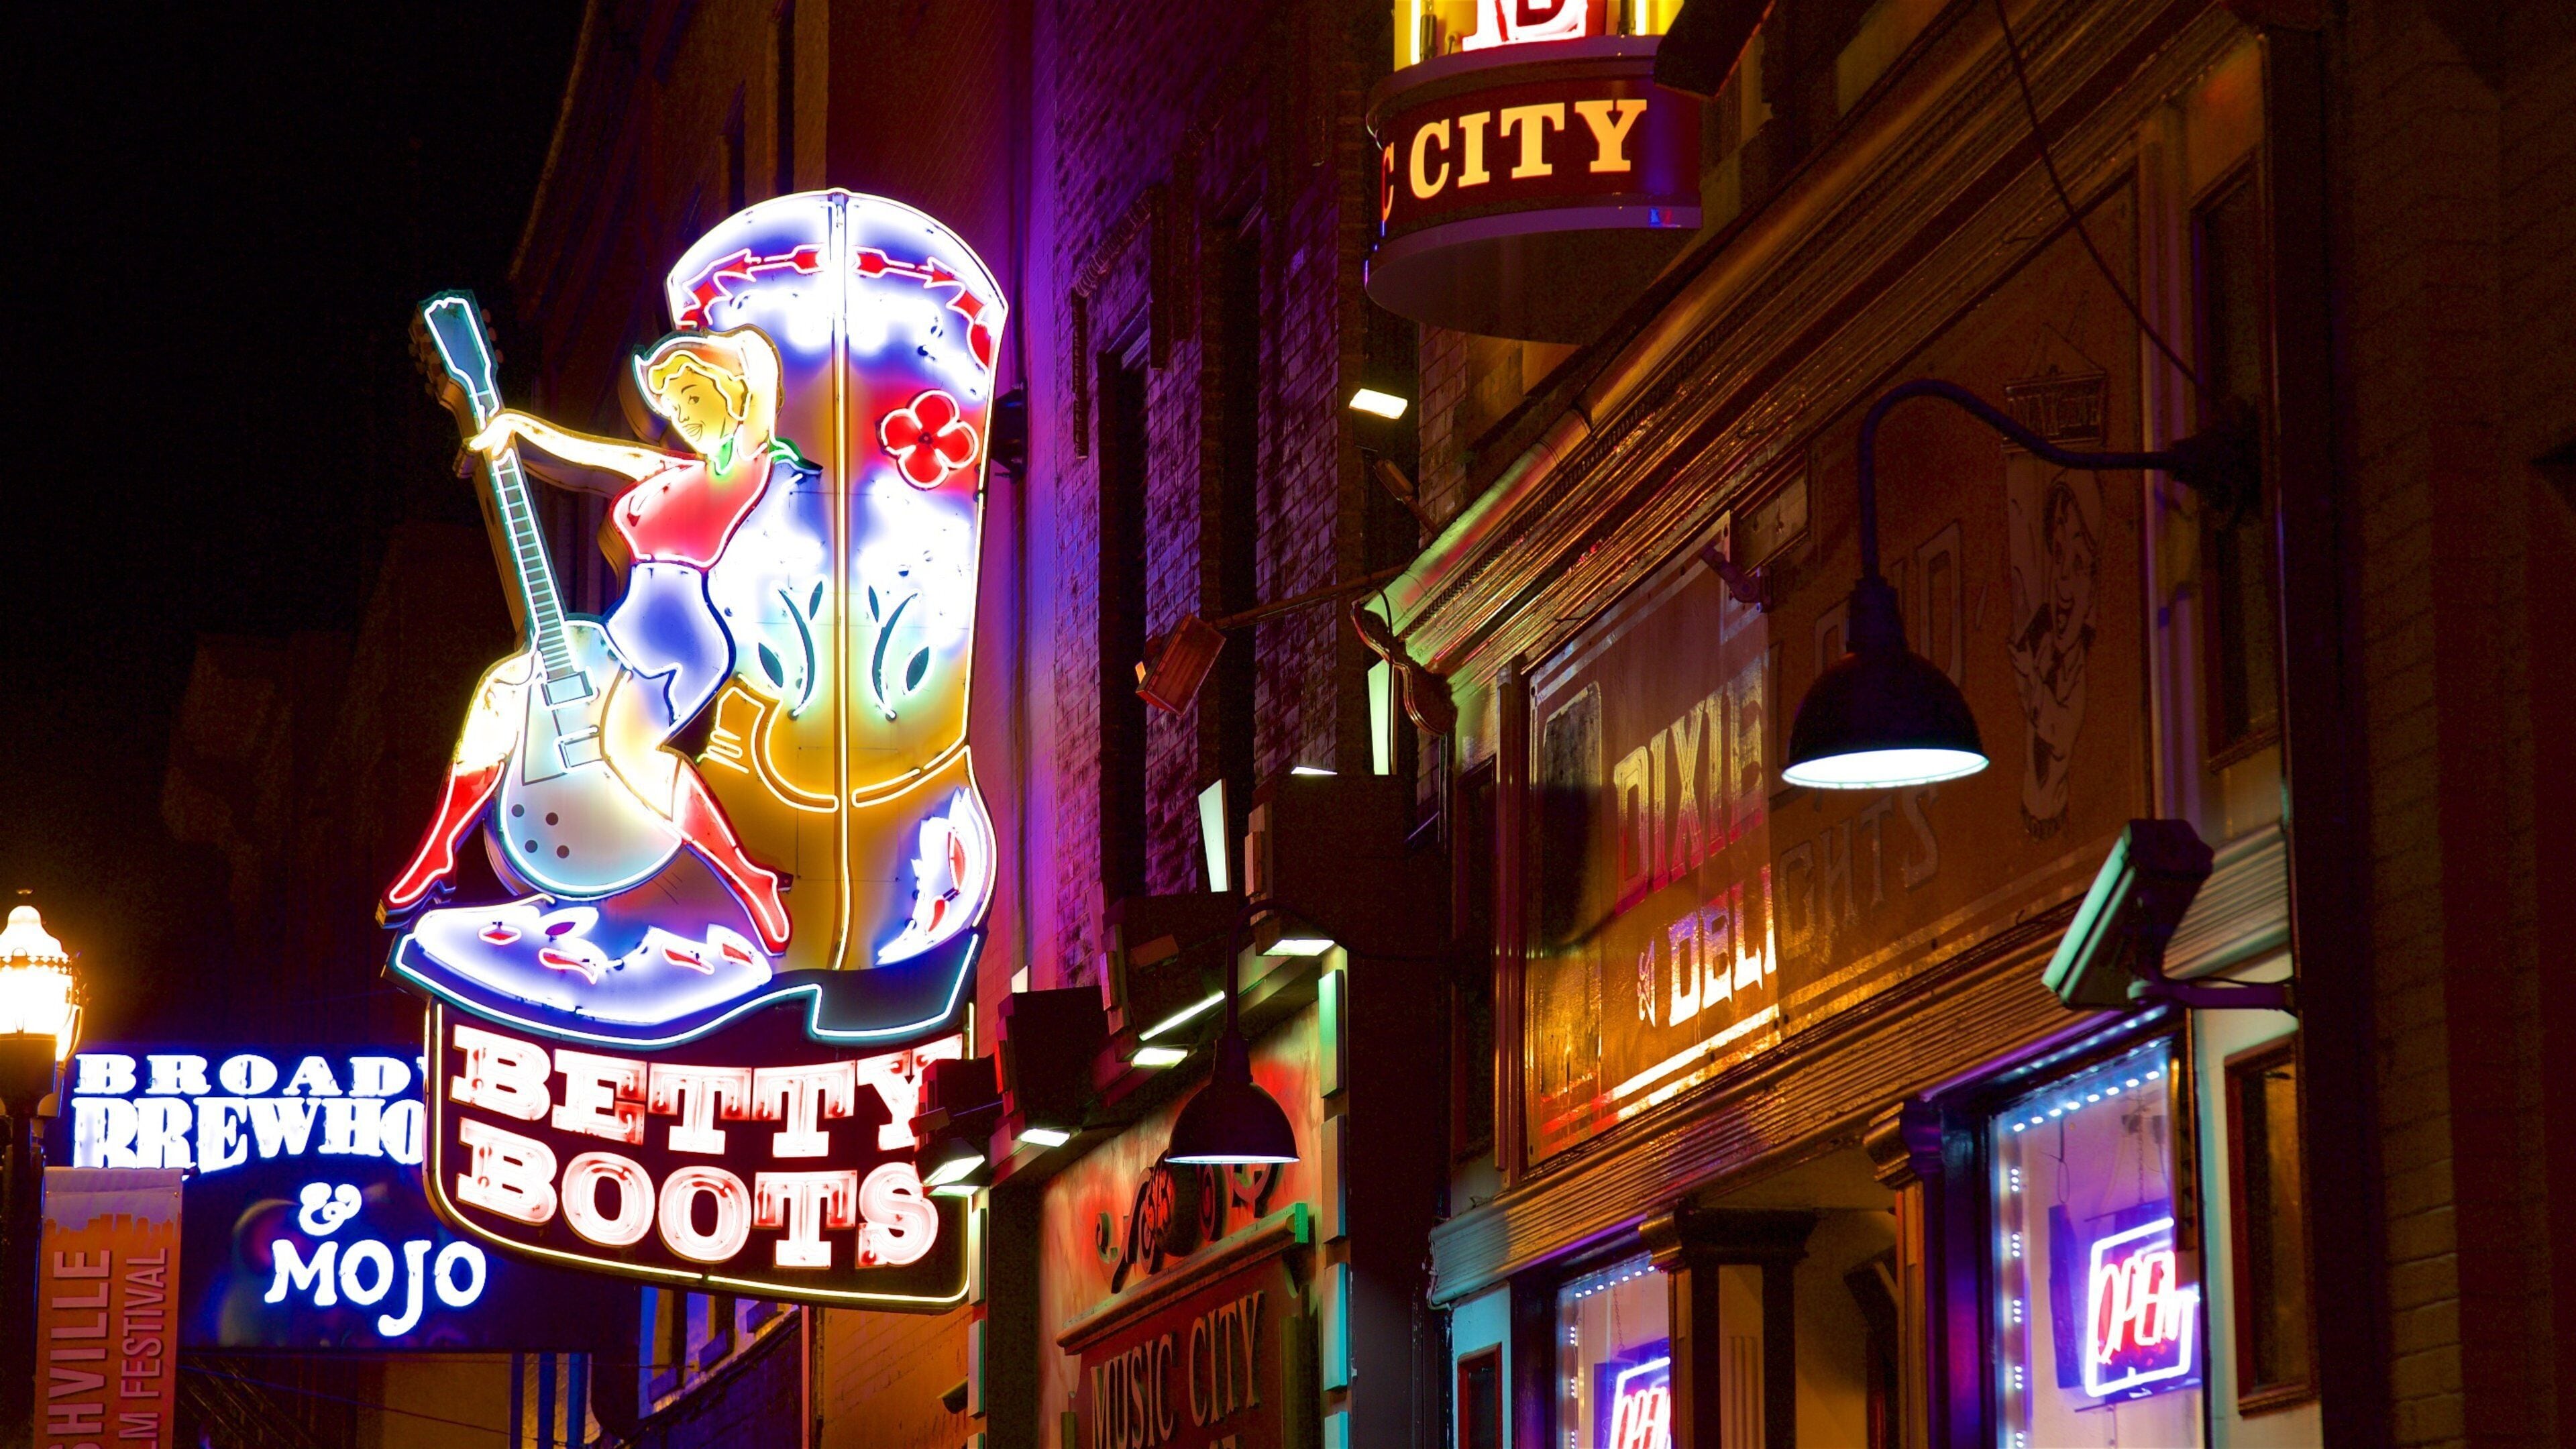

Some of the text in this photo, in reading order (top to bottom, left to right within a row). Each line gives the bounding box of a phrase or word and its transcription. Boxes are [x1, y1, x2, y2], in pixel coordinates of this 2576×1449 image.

[1410, 99, 1647, 199] CITY
[74, 1054, 425, 1097] BROAD
[450, 1024, 962, 1157] BETTY
[299, 1183, 362, 1236] &
[456, 1117, 938, 1269] BOOTS
[47, 1250, 110, 1449] HVILLE
[120, 1248, 165, 1397] FESTIVAL
[264, 1240, 486, 1336] MOJO
[1090, 1290, 1263, 1449] MUSIC CITY
